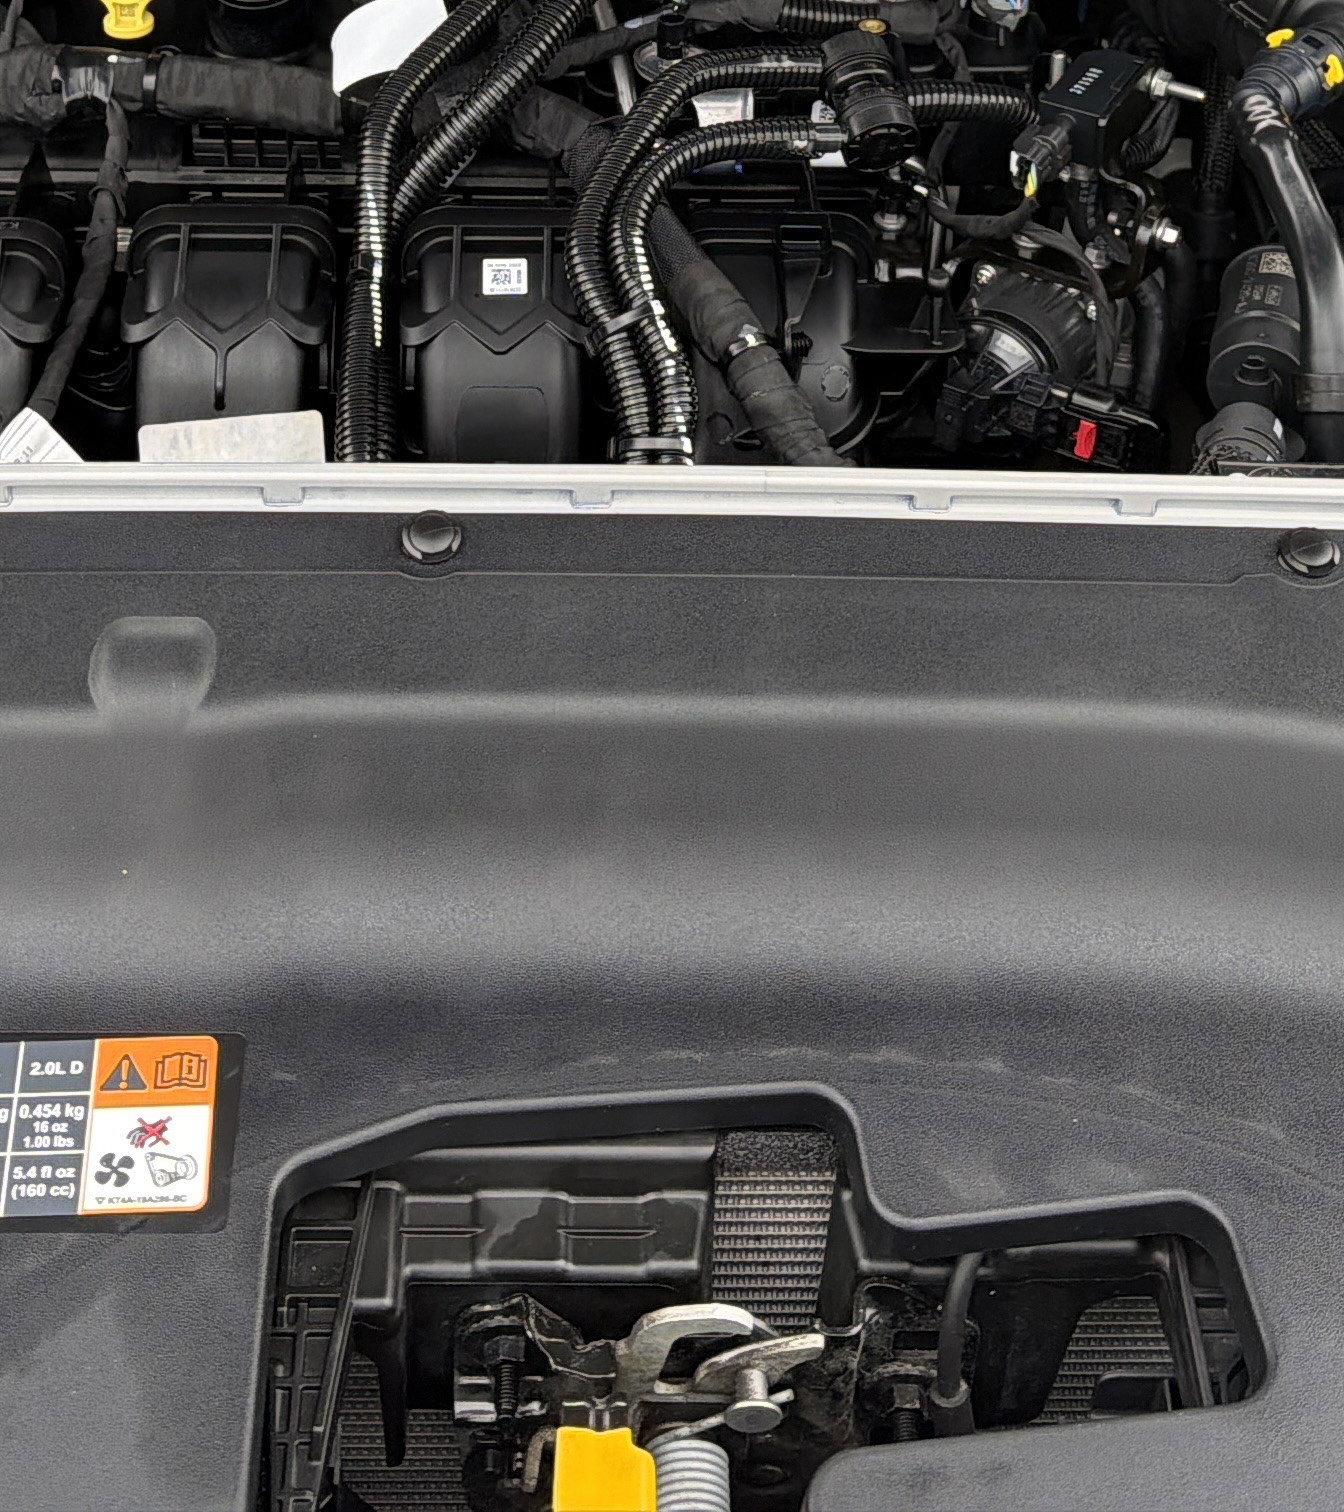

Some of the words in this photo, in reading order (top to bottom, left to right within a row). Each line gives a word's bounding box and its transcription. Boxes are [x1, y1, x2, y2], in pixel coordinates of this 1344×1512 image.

[29, 1061, 66, 1076] 2.0L
[70, 1060, 84, 1075] D
[19, 1104, 62, 1120] 0.454
[64, 1103, 85, 1121] kg
[33, 1121, 49, 1134] 16
[51, 1122, 69, 1134] oz
[23, 1136, 50, 1149] 1.00
[53, 1135, 75, 1148] lbs
[13, 1166, 37, 1180] 5.4
[40, 1165, 52, 1179] fl
[55, 1167, 76, 1179] oz
[11, 1183, 47, 1201] (160
[49, 1182, 76, 1199] cc)
